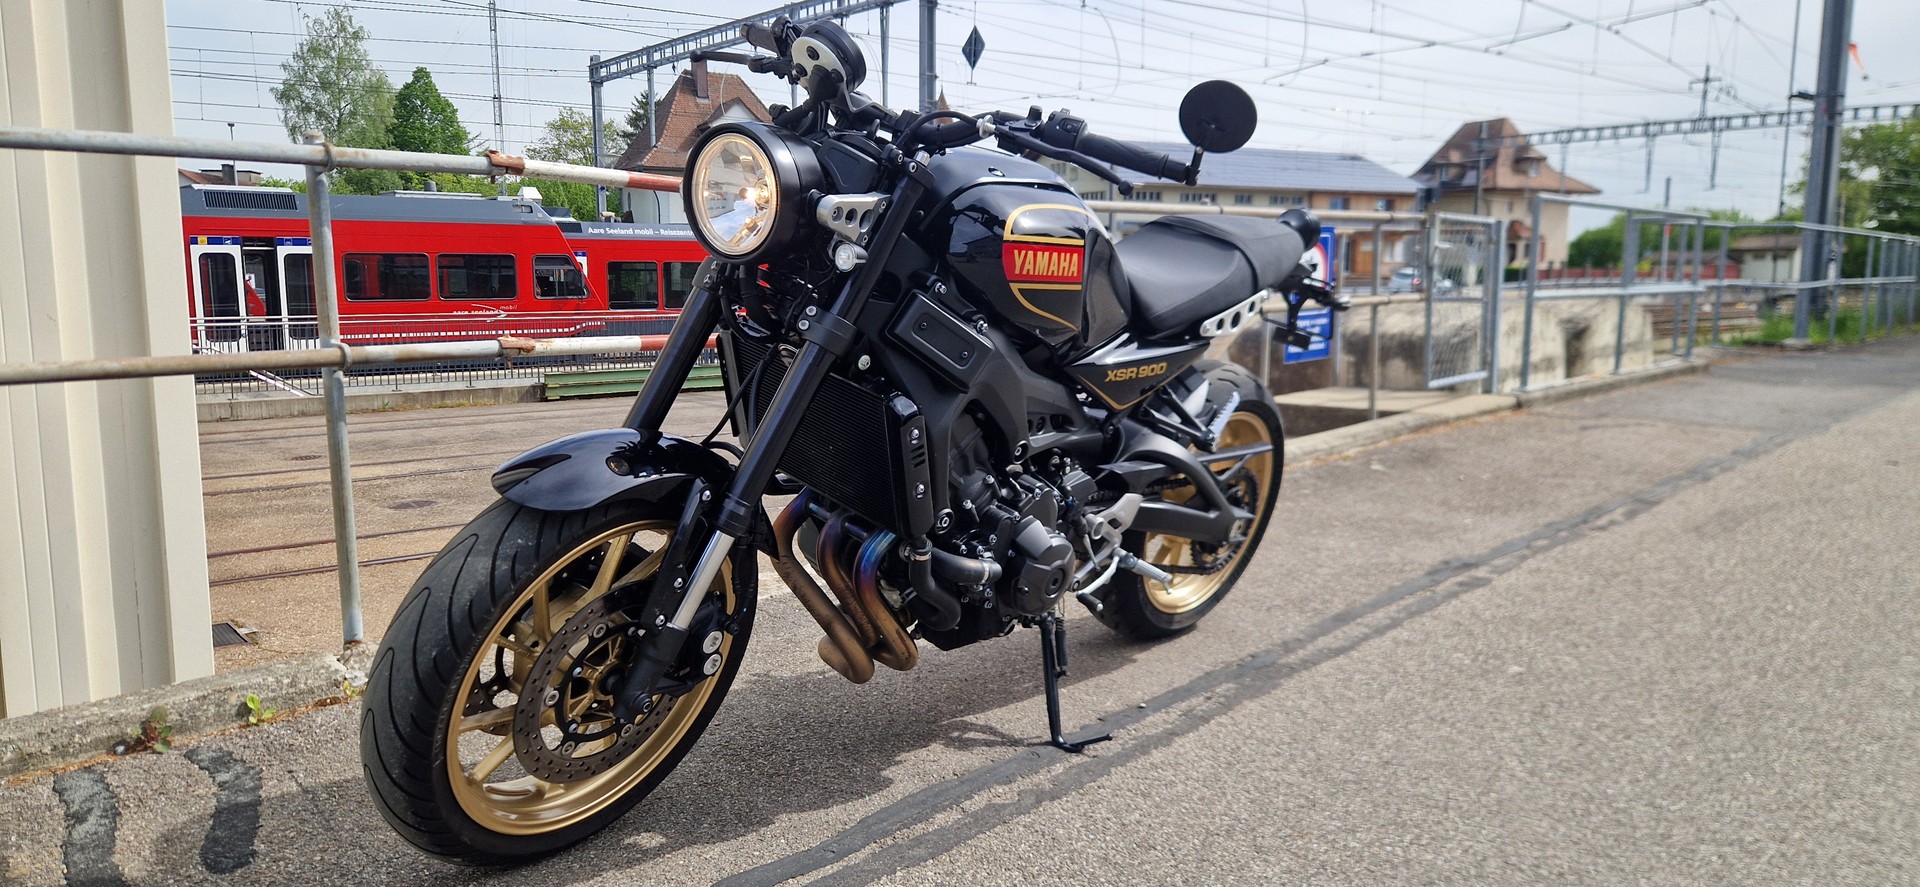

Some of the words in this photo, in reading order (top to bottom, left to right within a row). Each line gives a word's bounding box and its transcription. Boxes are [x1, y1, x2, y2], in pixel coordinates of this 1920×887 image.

[606, 227, 633, 235] Seeland
[660, 228, 695, 236] Reisezentr
[1013, 249, 1078, 276] YAMAHA
[1105, 367, 1137, 382] XSR
[1138, 362, 1168, 378] 900
